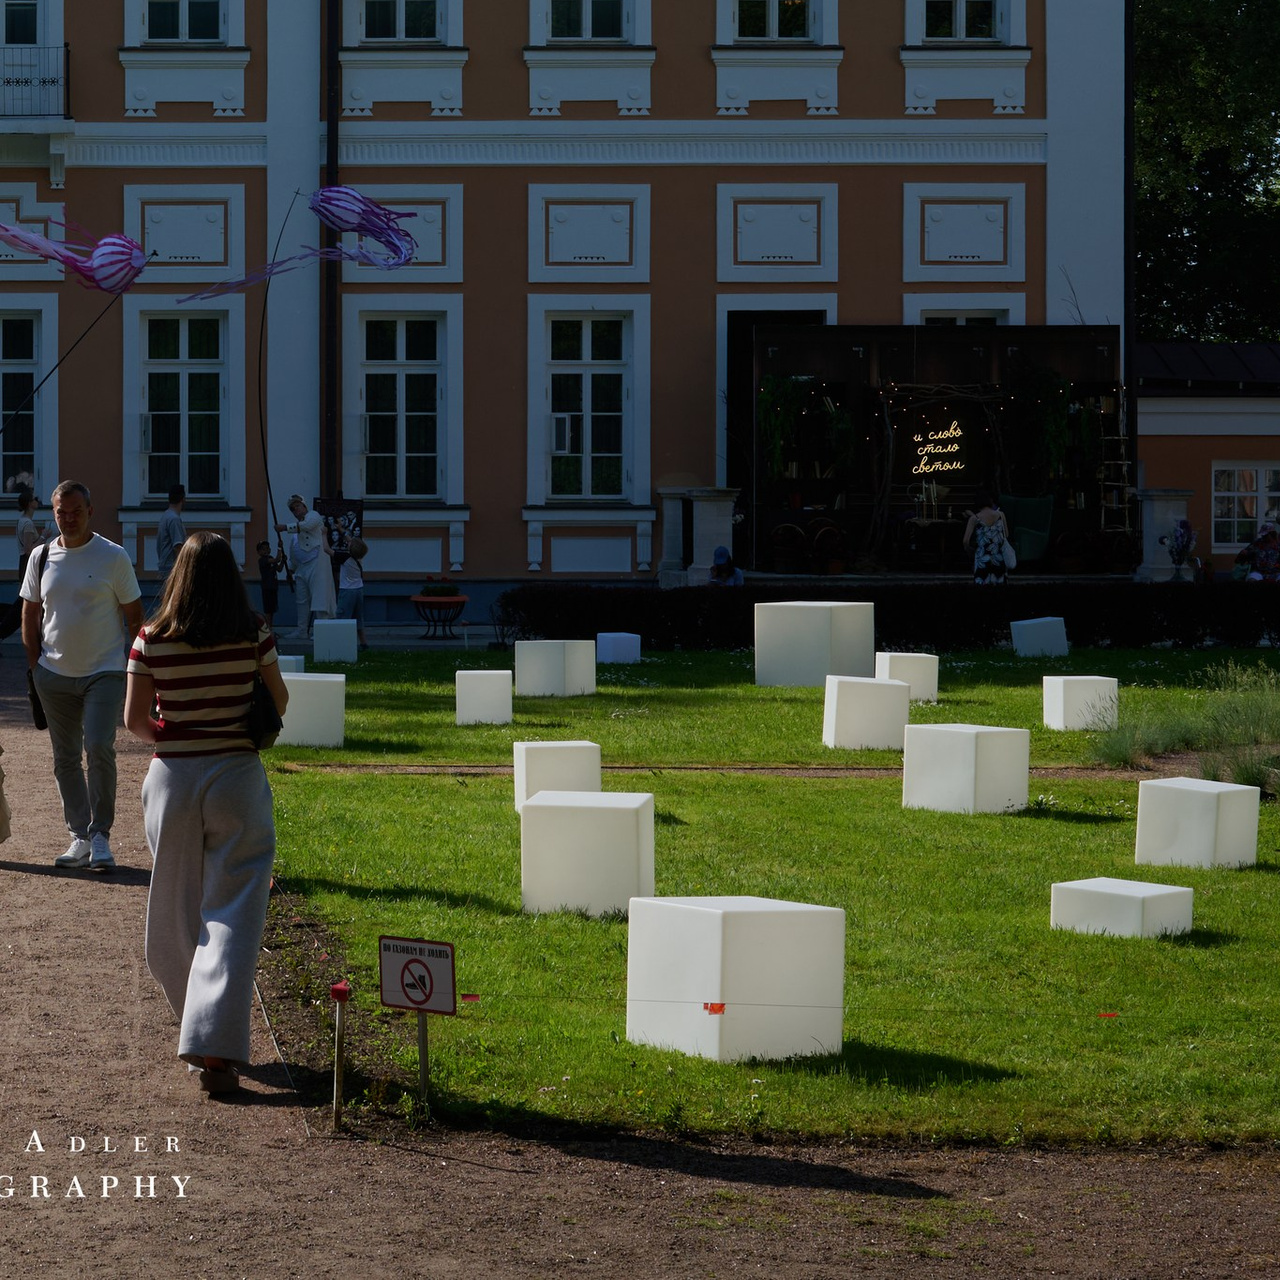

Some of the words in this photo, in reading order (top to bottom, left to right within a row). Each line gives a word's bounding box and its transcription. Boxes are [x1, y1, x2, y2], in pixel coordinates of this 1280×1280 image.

[913, 434, 923, 442] и
[928, 420, 963, 440] слово
[917, 443, 960, 456] стало
[912, 455, 965, 474] светом
[383, 943, 391, 952] ПО
[392, 944, 417, 955] ГАЗОНАМ
[419, 946, 426, 956] НЕ
[428, 948, 450, 959] ХОДИТЬ
